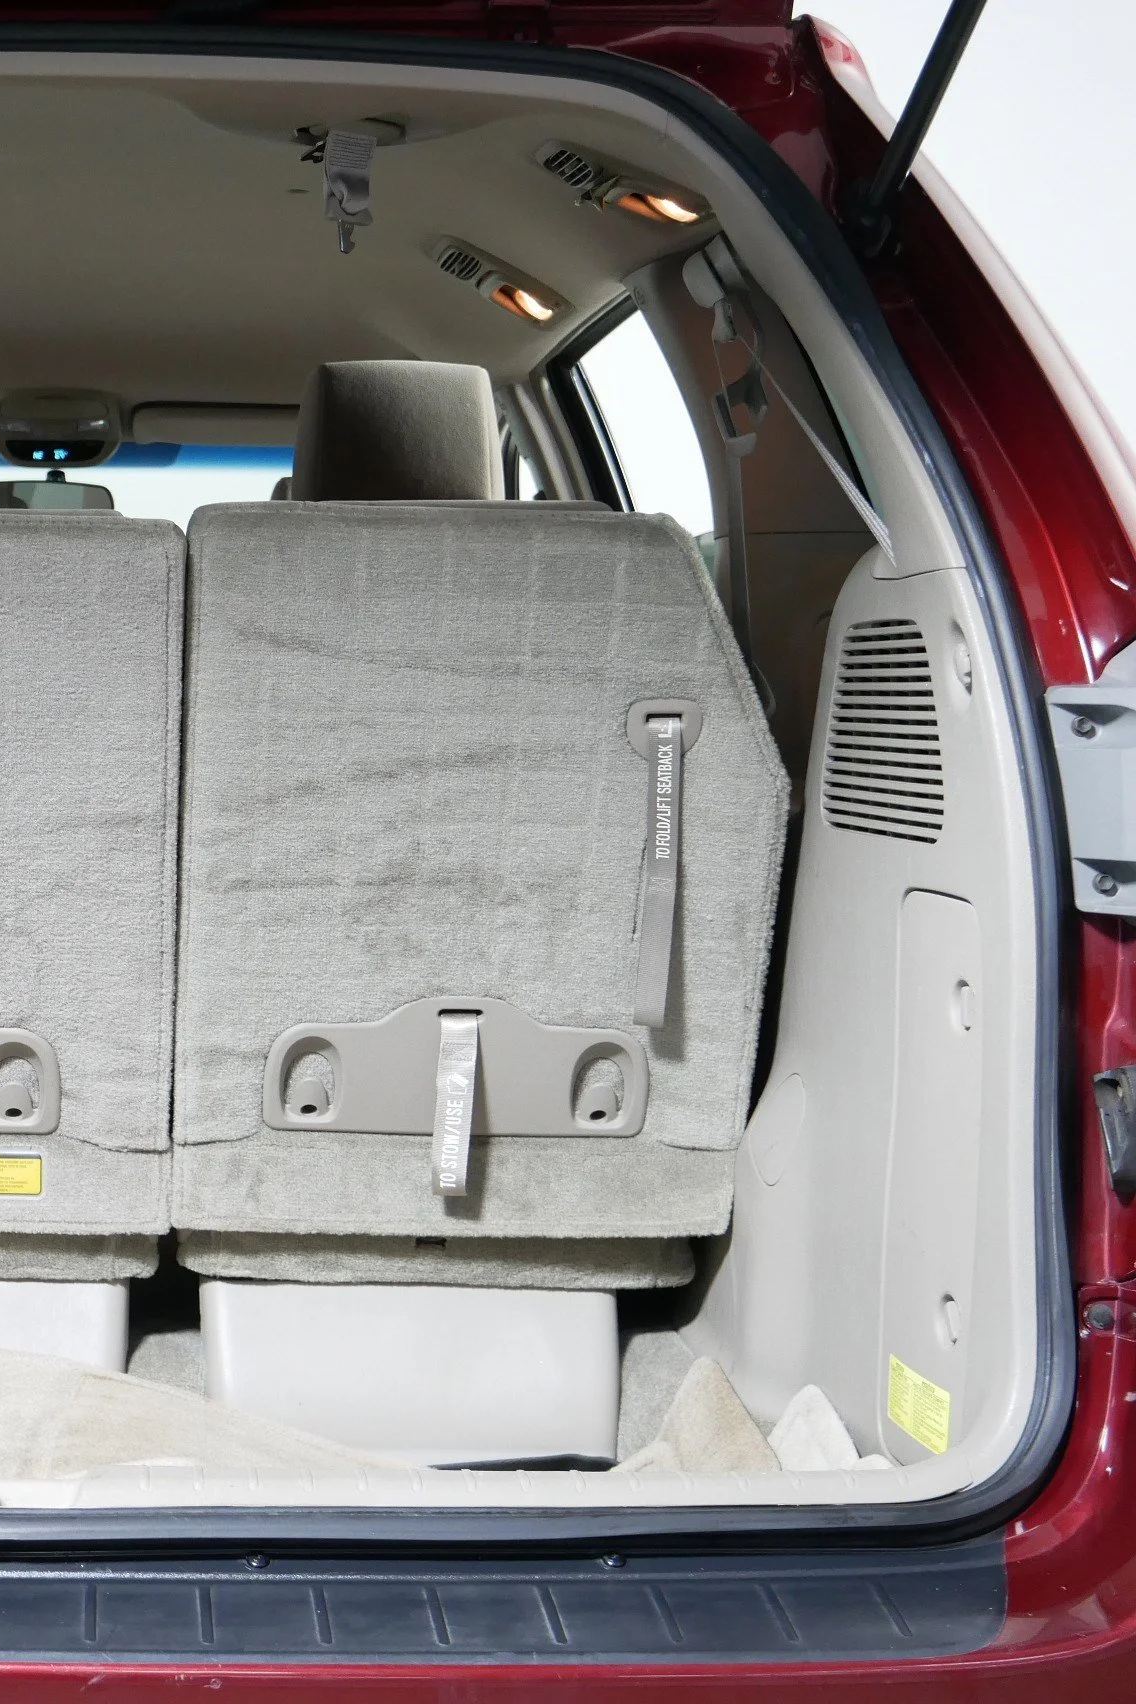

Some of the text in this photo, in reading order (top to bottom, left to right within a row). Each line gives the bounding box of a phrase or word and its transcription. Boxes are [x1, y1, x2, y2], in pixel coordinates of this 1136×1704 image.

[655, 744, 673, 860] TO FOLD/LIFT SEATBACK
[439, 1099, 464, 1189] TO STOW/USE
